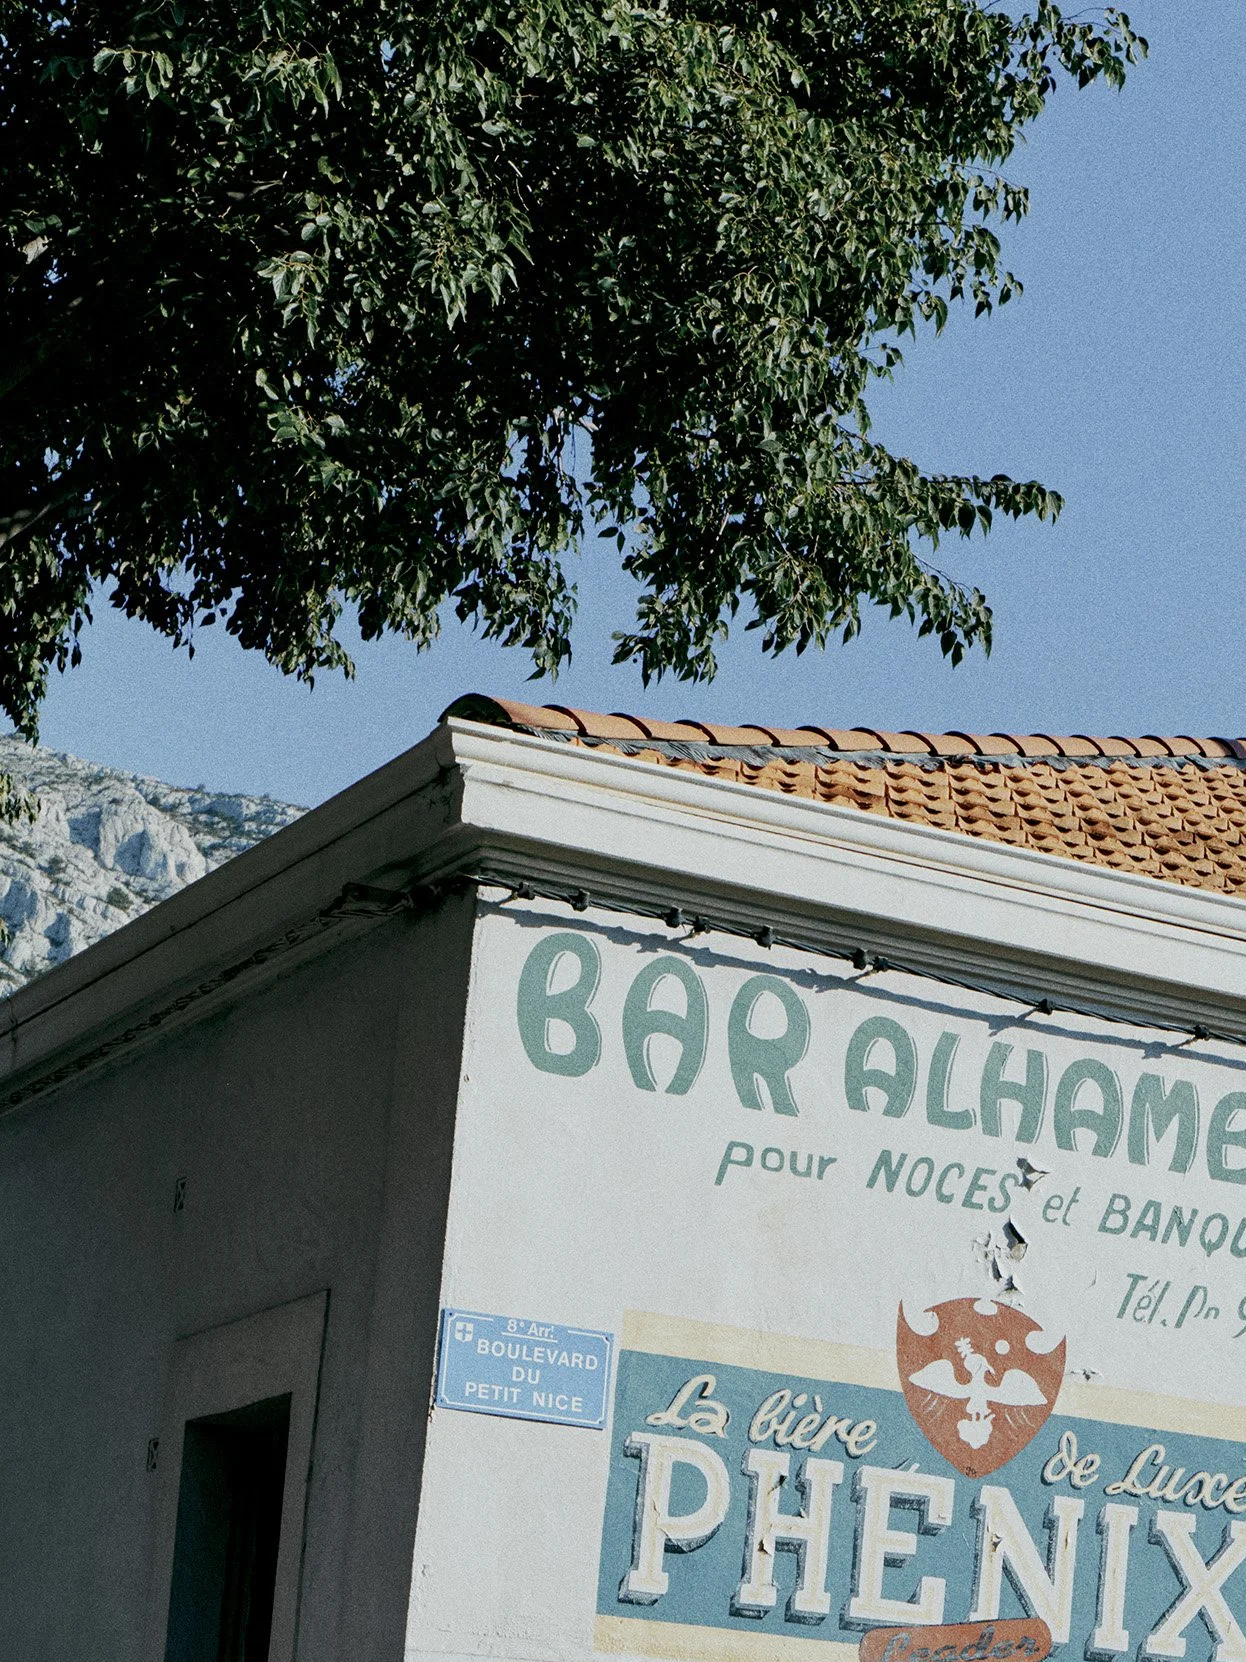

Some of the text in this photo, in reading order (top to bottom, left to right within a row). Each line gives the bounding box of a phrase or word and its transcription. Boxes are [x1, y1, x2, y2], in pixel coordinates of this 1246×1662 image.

[517, 932, 811, 1117] BAR
[714, 1141, 838, 1186] pour
[866, 1150, 1020, 1213] NOCES
[1042, 1186, 1081, 1226] et
[476, 1339, 599, 1370] BOULEVARD
[512, 1367, 540, 1384] DU
[465, 1382, 583, 1412] PETIT NICE
[646, 1374, 729, 1438] La
[749, 1388, 878, 1458] bière
[1042, 1431, 1101, 1489] de
